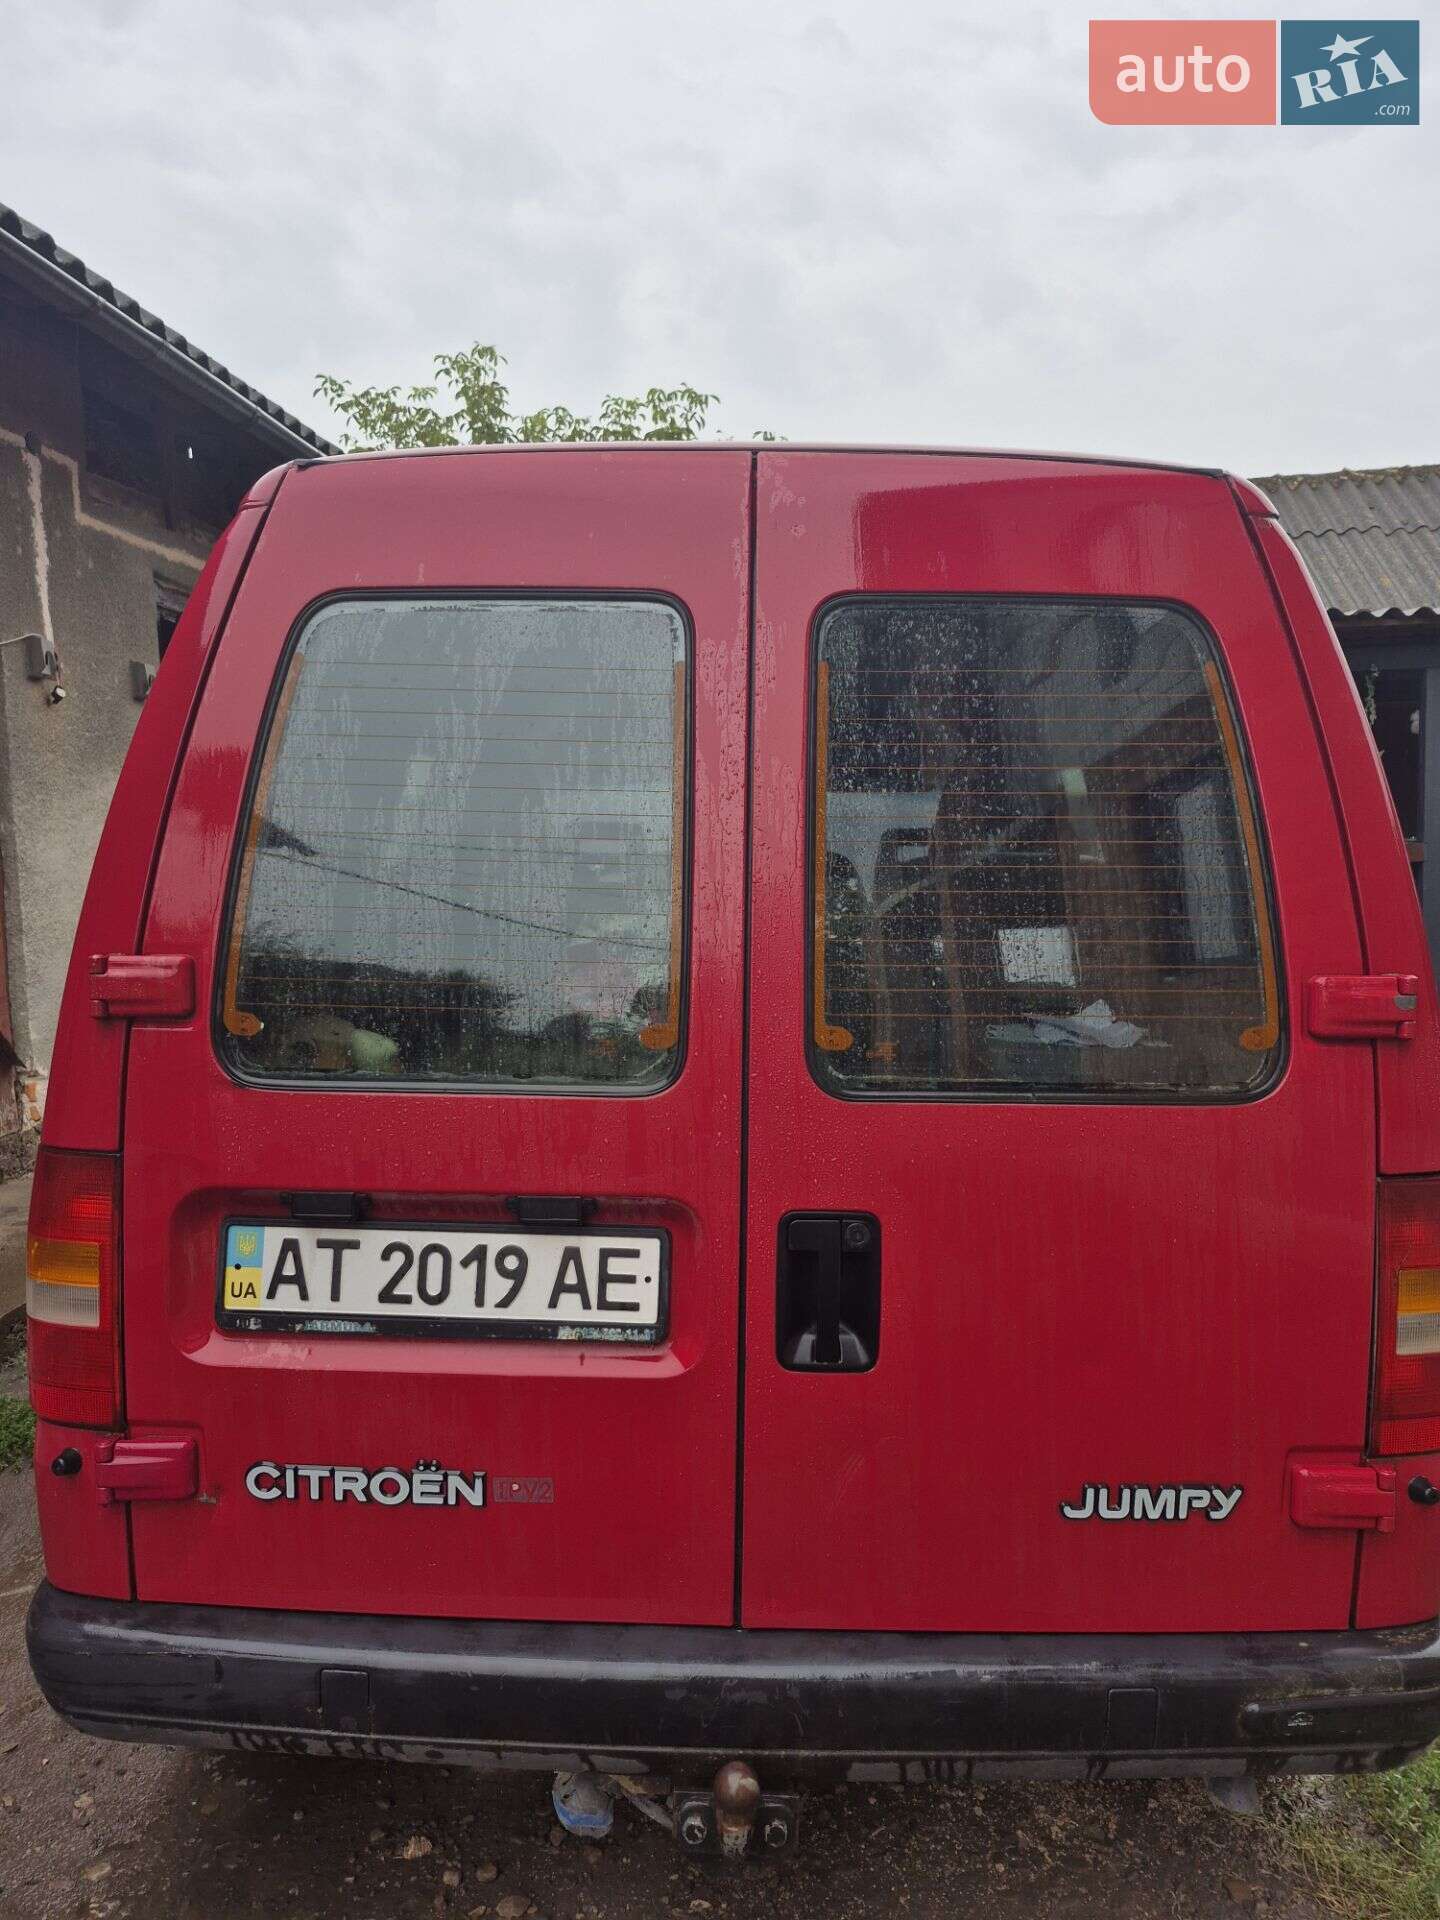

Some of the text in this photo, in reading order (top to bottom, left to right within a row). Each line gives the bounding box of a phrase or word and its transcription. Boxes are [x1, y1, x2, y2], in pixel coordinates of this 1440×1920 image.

[230, 1281, 257, 1299] UA
[266, 1237, 641, 1312] AT 2019 AE
[245, 1459, 487, 1507] CITROËN
[1061, 1484, 1243, 1522] JUMPY
